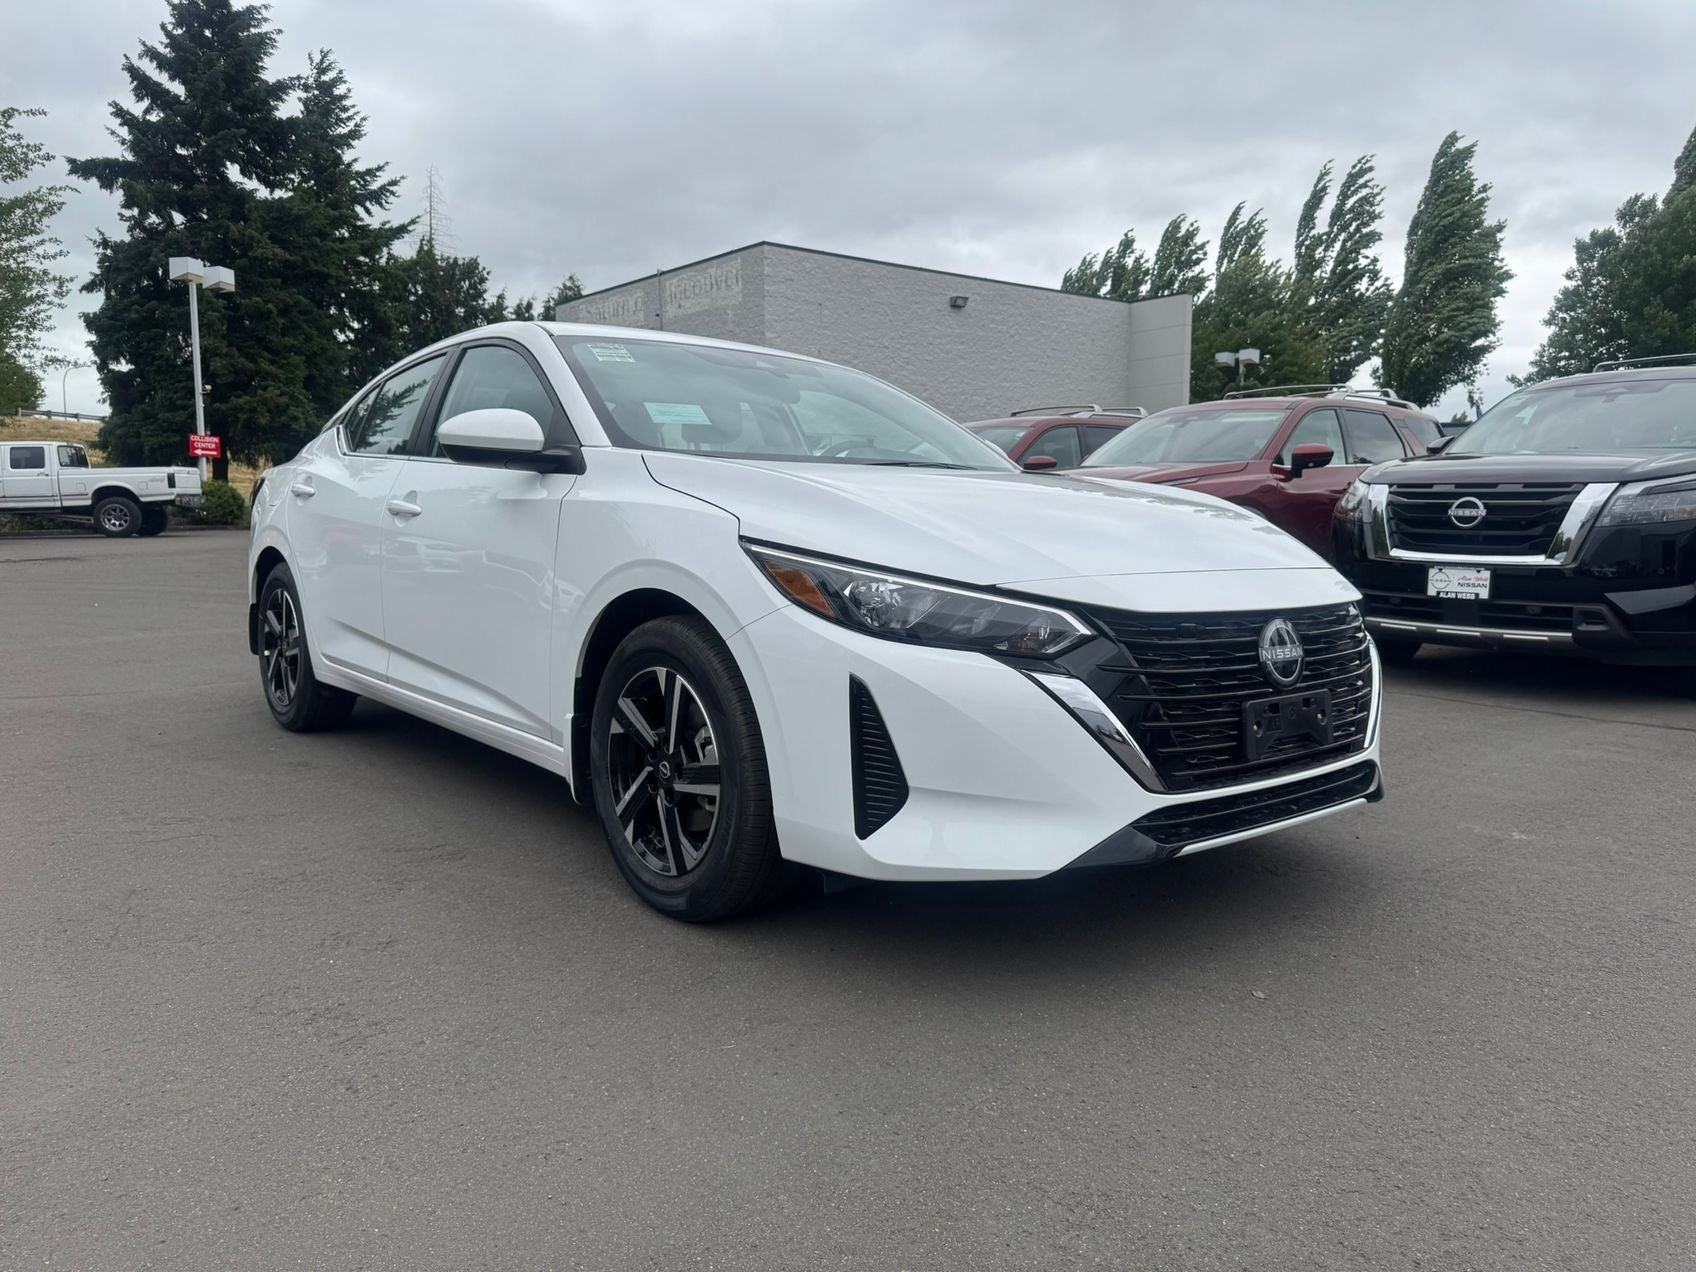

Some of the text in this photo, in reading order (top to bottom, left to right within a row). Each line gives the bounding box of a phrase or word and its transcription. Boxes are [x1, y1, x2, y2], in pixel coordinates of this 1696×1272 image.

[194, 441, 216, 449] CENTER
[1448, 508, 1487, 516] NISSAN
[1439, 591, 1476, 600] ALAN WEBB
[1261, 645, 1303, 660] NISSAN
